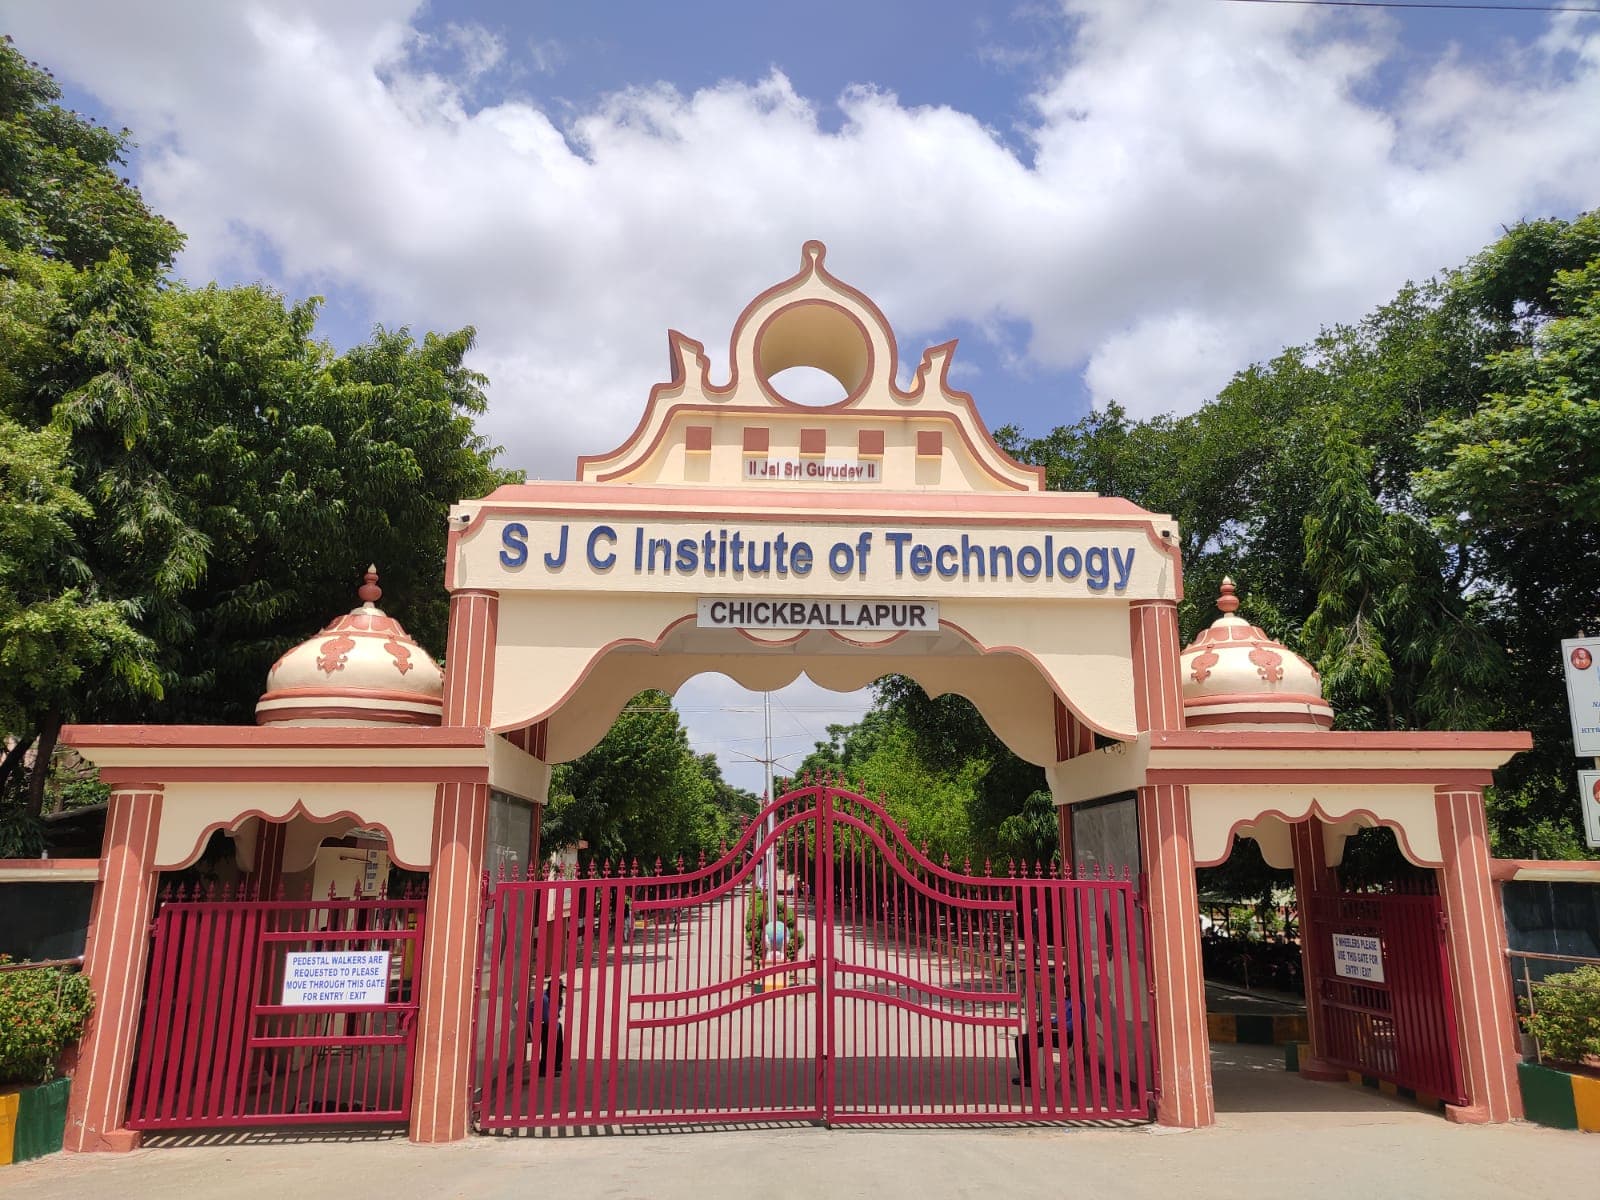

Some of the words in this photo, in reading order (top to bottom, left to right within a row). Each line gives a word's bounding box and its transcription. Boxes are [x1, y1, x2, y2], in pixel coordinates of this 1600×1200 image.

[806, 462, 863, 478] Gurudev
[634, 528, 813, 574] Institute
[829, 532, 872, 575] of
[885, 532, 1136, 591] Technology
[710, 602, 927, 627] CHICKBALLAPUR
[293, 956, 329, 966] PEDESTAL
[331, 955, 367, 965] WALKERS
[368, 954, 383, 964] ARE
[1347, 951, 1357, 962] THIS
[1357, 953, 1369, 964] GATE
[294, 968, 338, 977] REQUESTED
[340, 968, 350, 977] TO
[352, 967, 379, 976] PLEASE
[286, 980, 307, 990] MOVE
[309, 980, 345, 989] THROUGH
[347, 979, 364, 988] THIS
[366, 979, 385, 988] GATE
[303, 992, 318, 1001] FOR
[319, 991, 343, 1001] ENTRY
[350, 991, 367, 1000] EXIT
